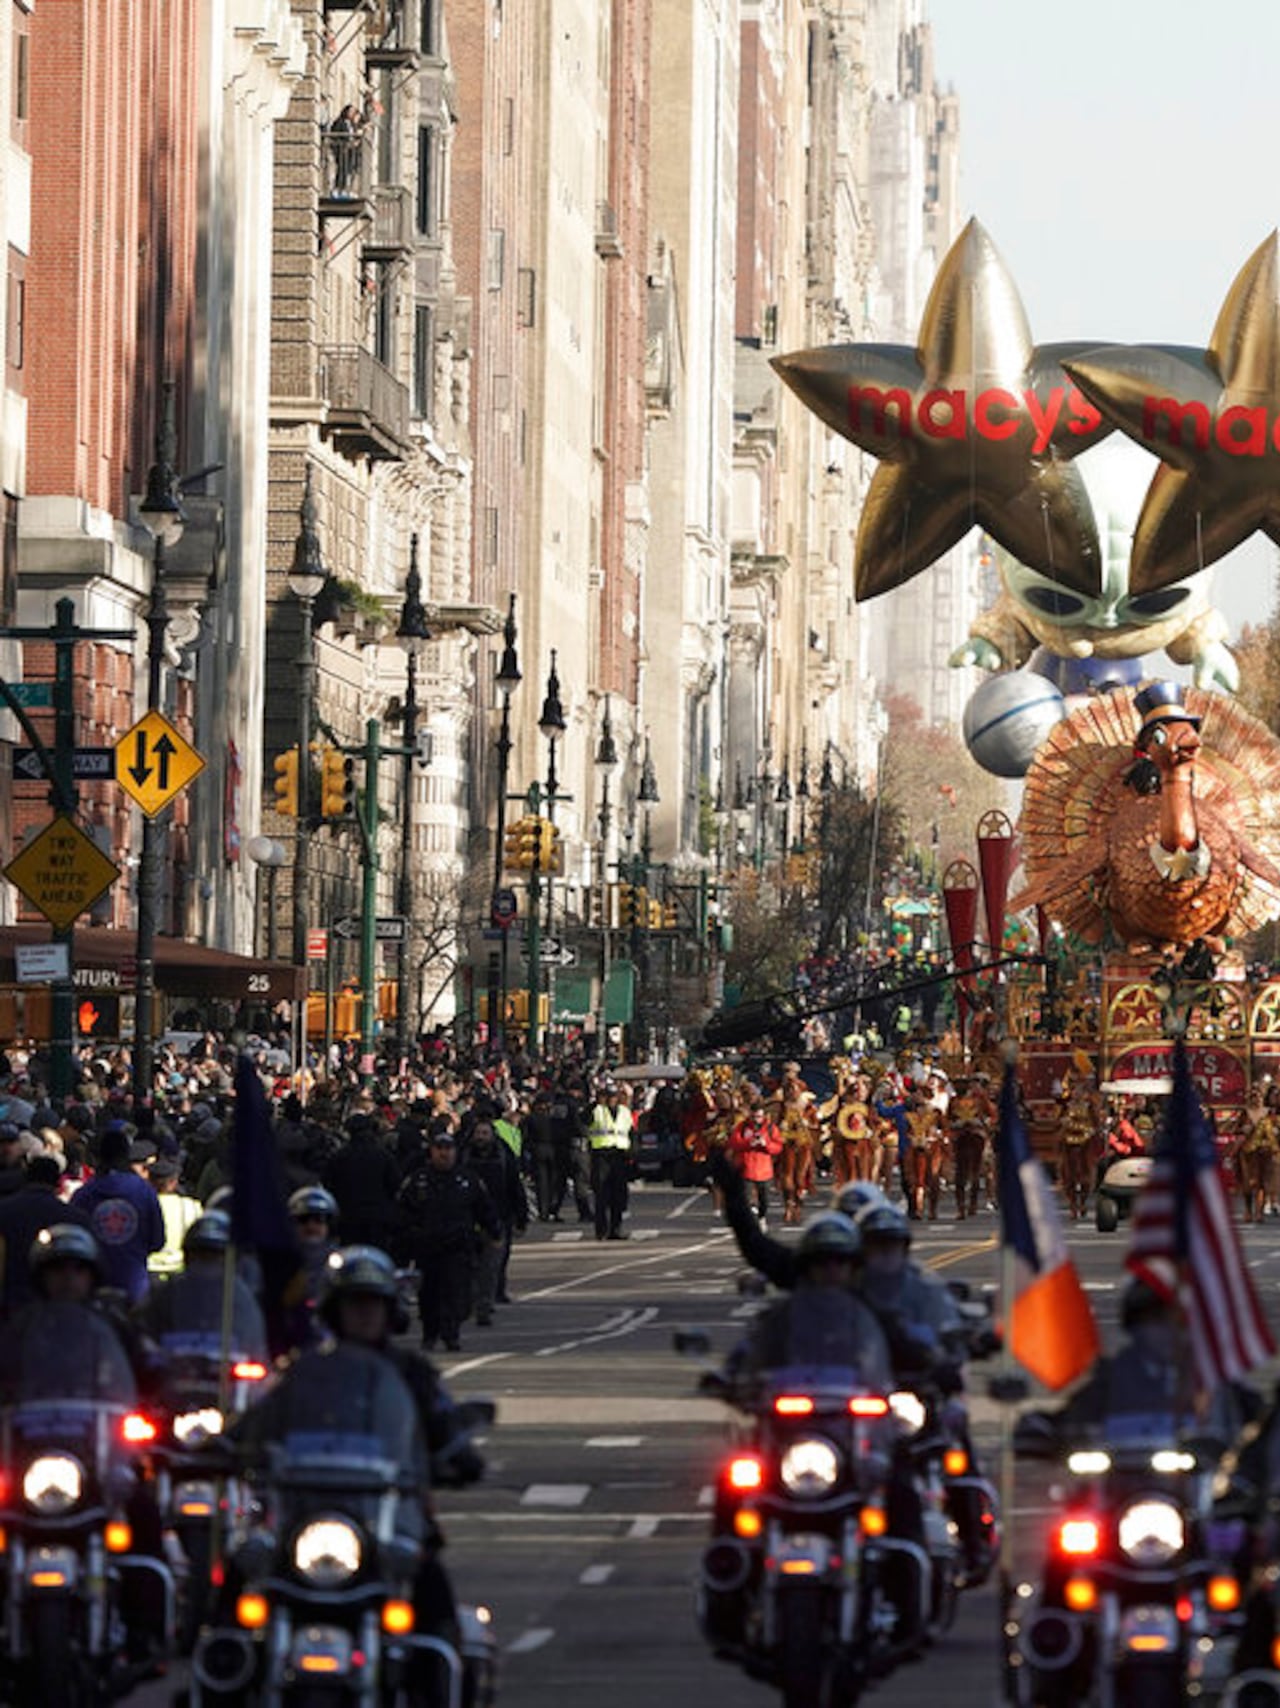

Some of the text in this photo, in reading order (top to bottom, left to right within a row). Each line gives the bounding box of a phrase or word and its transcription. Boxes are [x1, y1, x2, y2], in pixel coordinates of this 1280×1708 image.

[50, 837, 76, 850] TWO
[49, 854, 74, 867] WAY
[35, 872, 88, 886] TRAFFIC
[41, 890, 84, 903] AHEAD
[248, 974, 271, 992] 25
